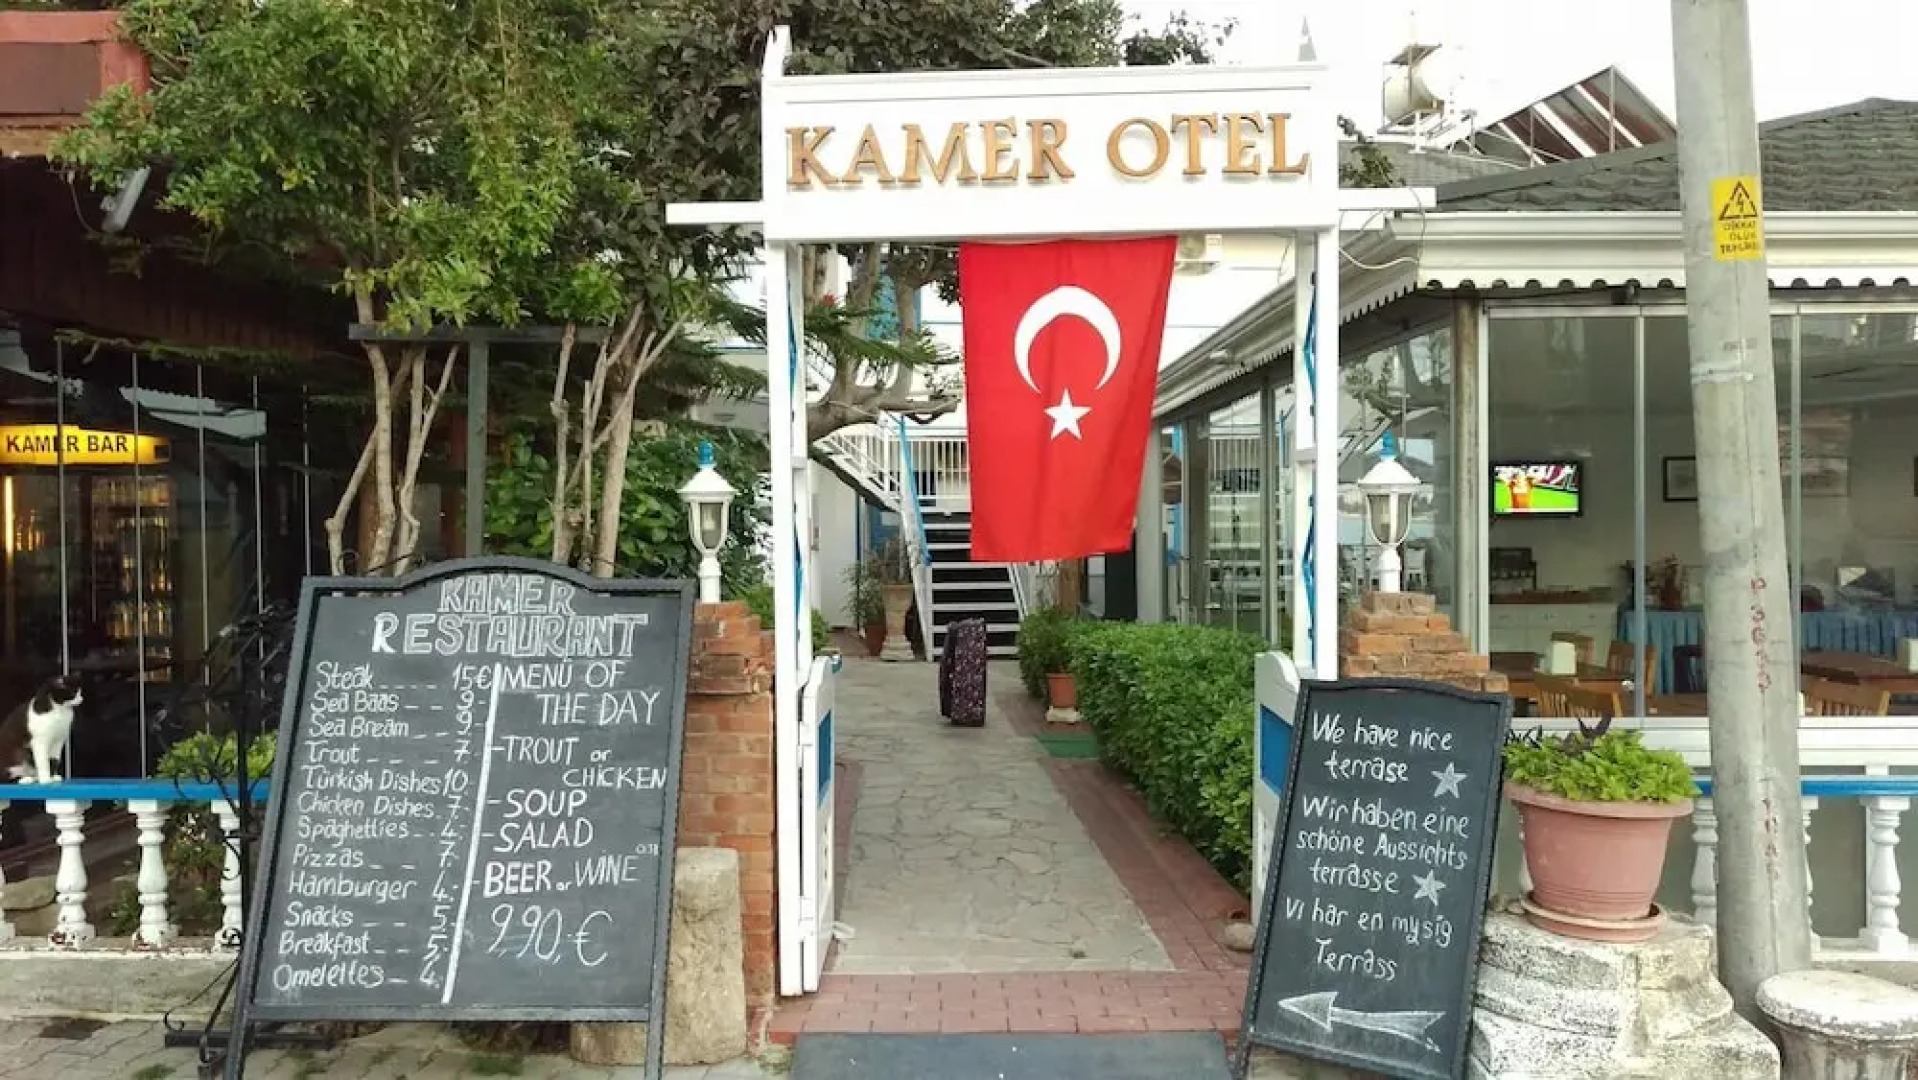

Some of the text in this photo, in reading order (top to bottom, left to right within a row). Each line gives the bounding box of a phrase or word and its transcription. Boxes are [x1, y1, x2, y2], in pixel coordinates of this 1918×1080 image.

[786, 111, 1311, 186] KAMER OTEL
[87, 434, 129, 453] BAR
[437, 574, 576, 616] KAMER
[371, 611, 648, 658] RESTAURANT
[316, 661, 491, 690] Steak 15€
[586, 660, 626, 688] OF
[310, 689, 349, 713] Sea
[537, 690, 660, 725] THE DAY
[308, 712, 346, 737] Sea
[350, 715, 410, 738] Bream
[1312, 709, 1453, 751] We have nice
[304, 740, 360, 764] Trout
[590, 749, 612, 763] or
[1323, 750, 1409, 784] terrase
[379, 768, 442, 794] Dishes
[297, 790, 365, 816] Chicken
[374, 795, 435, 818] Dishes
[1302, 795, 1470, 839] Wir haben eine
[292, 843, 364, 868] Pizzas
[1296, 826, 1468, 870] schöne Aussichts
[288, 870, 417, 905] Hamburger
[556, 880, 572, 892] or
[1309, 857, 1400, 893] terrasse
[283, 900, 354, 928] Snacks
[1312, 897, 1348, 927] har
[1357, 912, 1384, 931] en
[1391, 914, 1453, 948] mysig
[279, 929, 370, 961] Breakfast
[1315, 937, 1398, 981] Terrass
